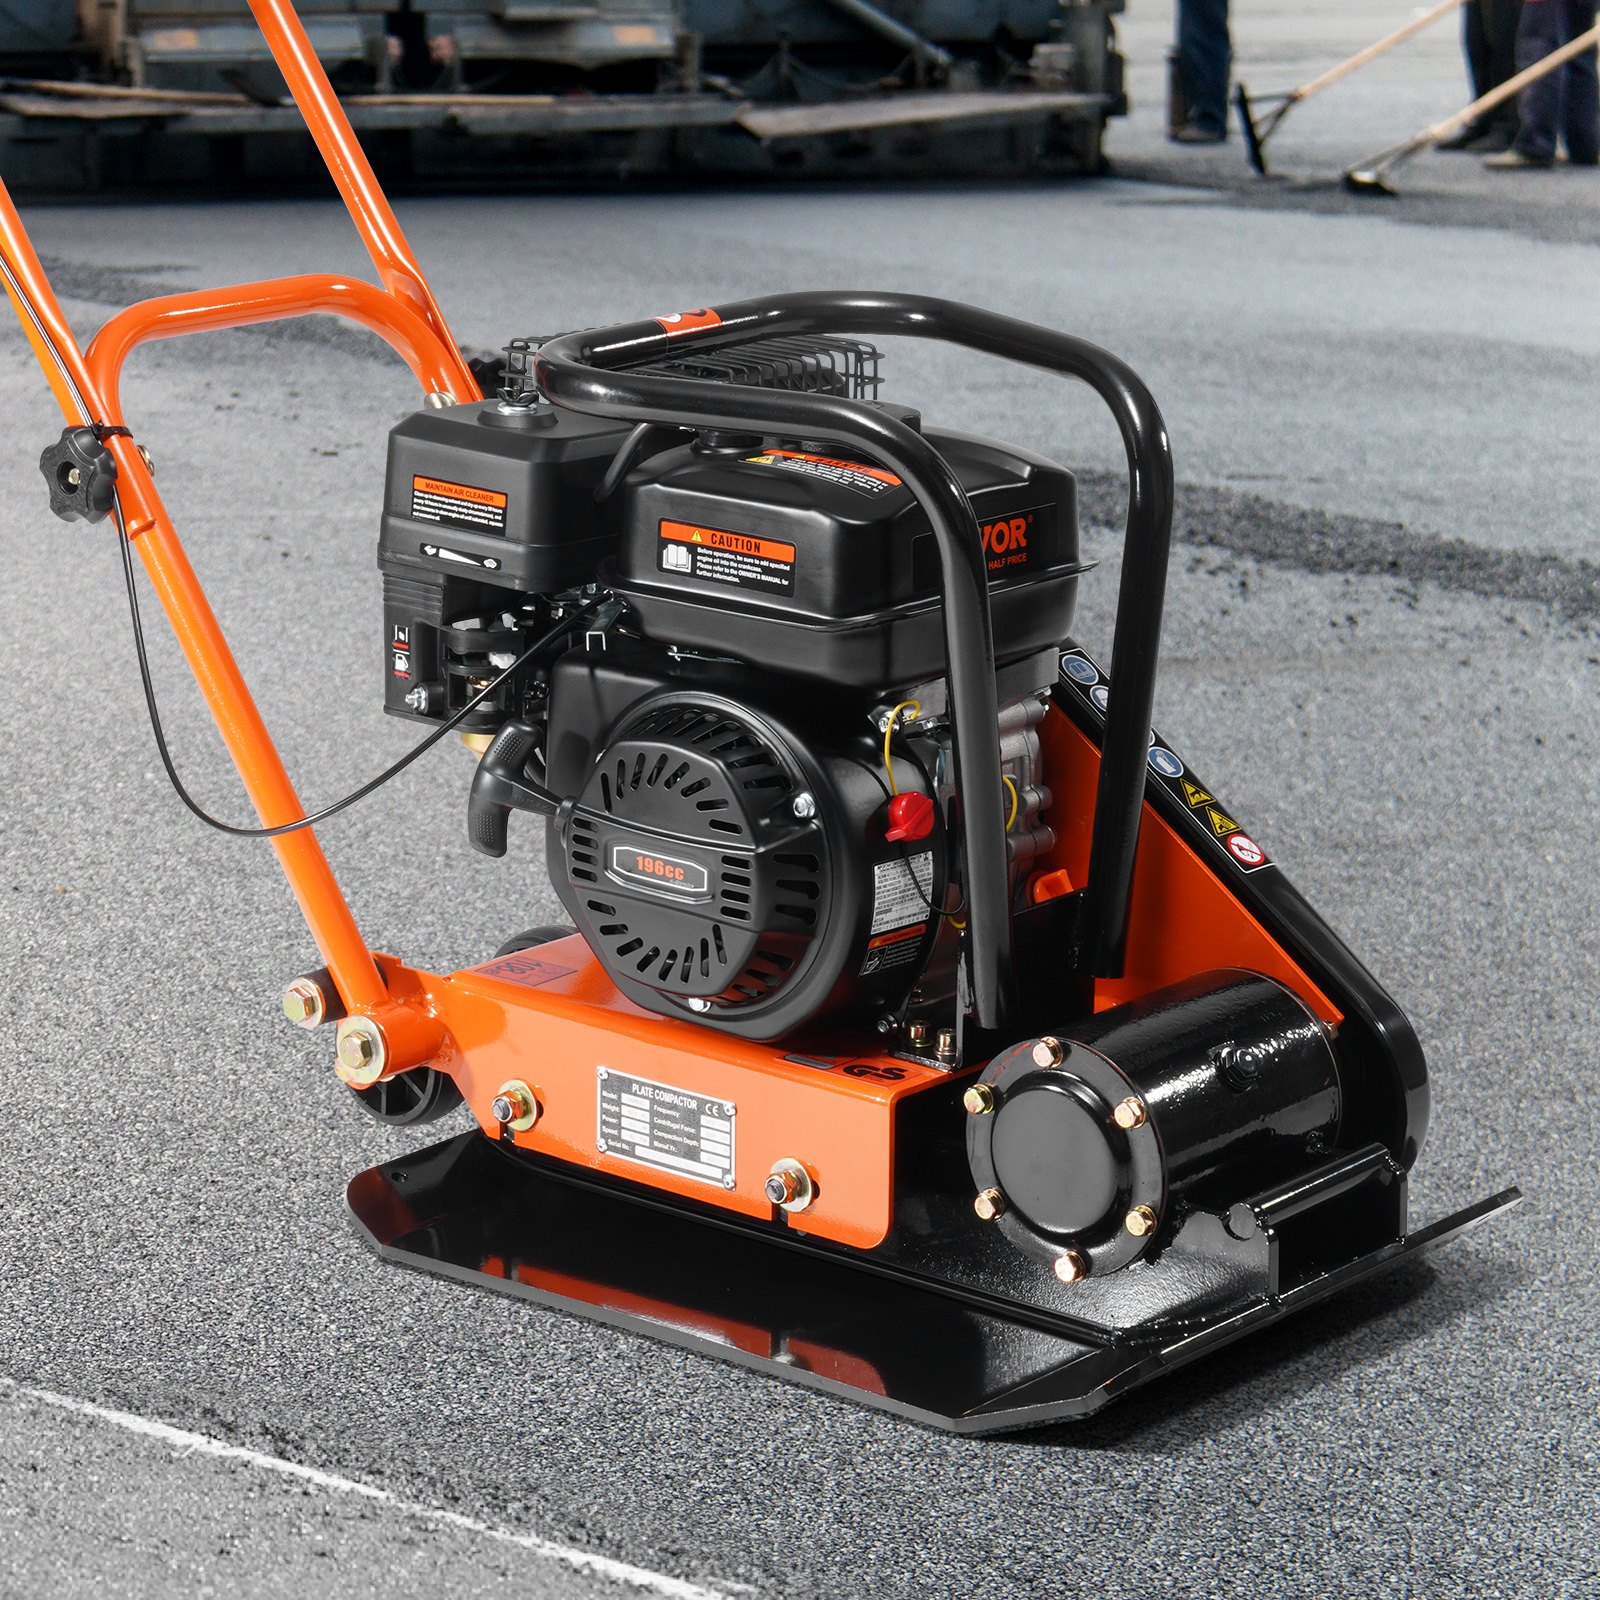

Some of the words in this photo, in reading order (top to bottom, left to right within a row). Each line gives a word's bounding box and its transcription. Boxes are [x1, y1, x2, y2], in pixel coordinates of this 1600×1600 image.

[425, 482, 453, 494] MAINTAIN
[454, 488, 465, 497] AIR
[465, 491, 494, 502] CLEANER
[979, 517, 1027, 553] VOR
[711, 533, 761, 553] CAUTION
[697, 547, 713, 555] Before
[713, 550, 736, 560] operation,
[744, 556, 753, 564] sure
[769, 562, 790, 571] specified
[697, 555, 713, 564] engine
[720, 558, 729, 566] into
[730, 560, 738, 568] the
[988, 557, 1006, 570] HALF
[1007, 552, 1027, 565] PRICE
[696, 569, 712, 578] further
[697, 562, 712, 570] Please
[713, 564, 724, 572] refer
[738, 569, 761, 580] OWNER'S
[761, 574, 782, 584] MANUAL
[782, 578, 790, 586] for
[636, 855, 685, 881] 196cc
[602, 1090, 619, 1100] Model:
[632, 1083, 654, 1098] PLATE
[654, 1089, 698, 1111] COMPACTOR
[602, 1102, 620, 1113] Weight:
[705, 1103, 719, 1117] CE
[602, 1114, 619, 1124] Power:
[654, 1129, 683, 1142] Compaction
[681, 1124, 697, 1134] Force:
[608, 1138, 621, 1148] Serial
